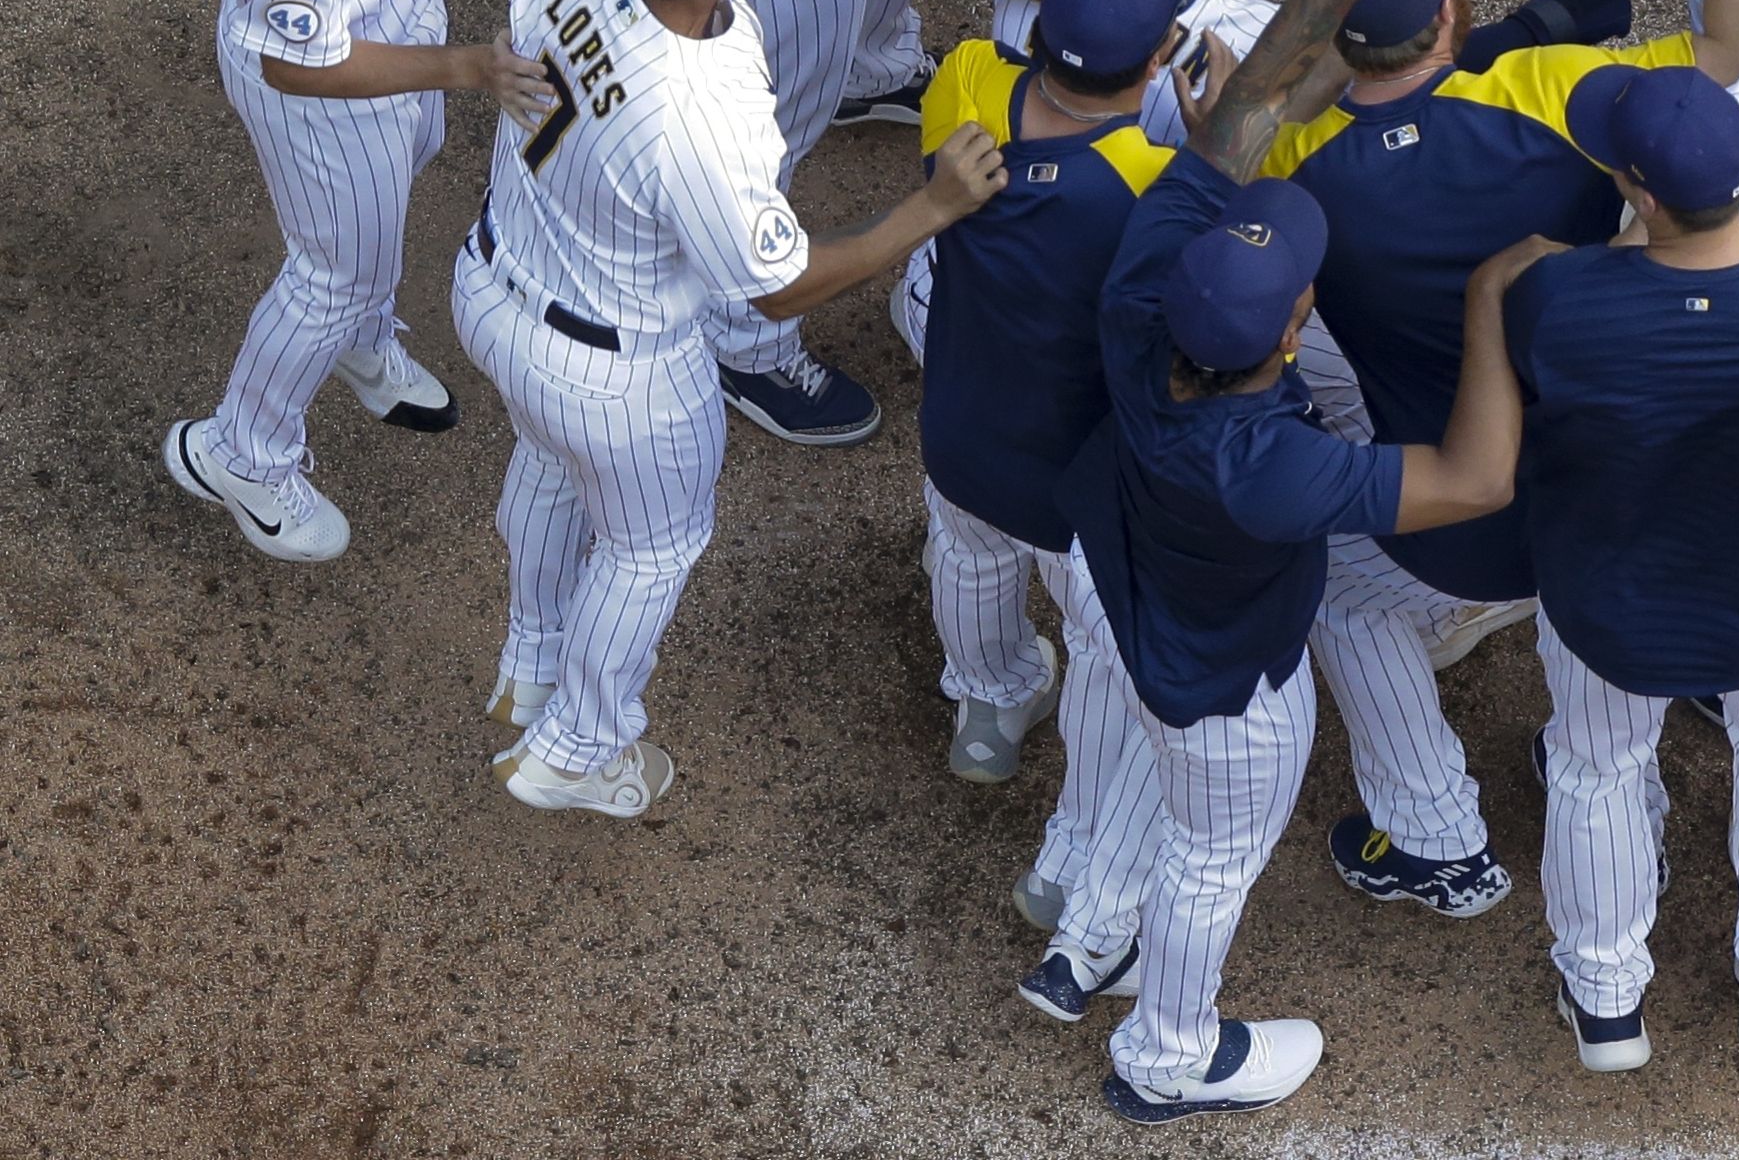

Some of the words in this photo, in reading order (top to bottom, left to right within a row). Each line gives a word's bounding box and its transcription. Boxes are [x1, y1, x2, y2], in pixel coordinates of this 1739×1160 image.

[269, 9, 312, 37] 44
[519, 45, 581, 184] 7
[760, 214, 793, 254] 44
